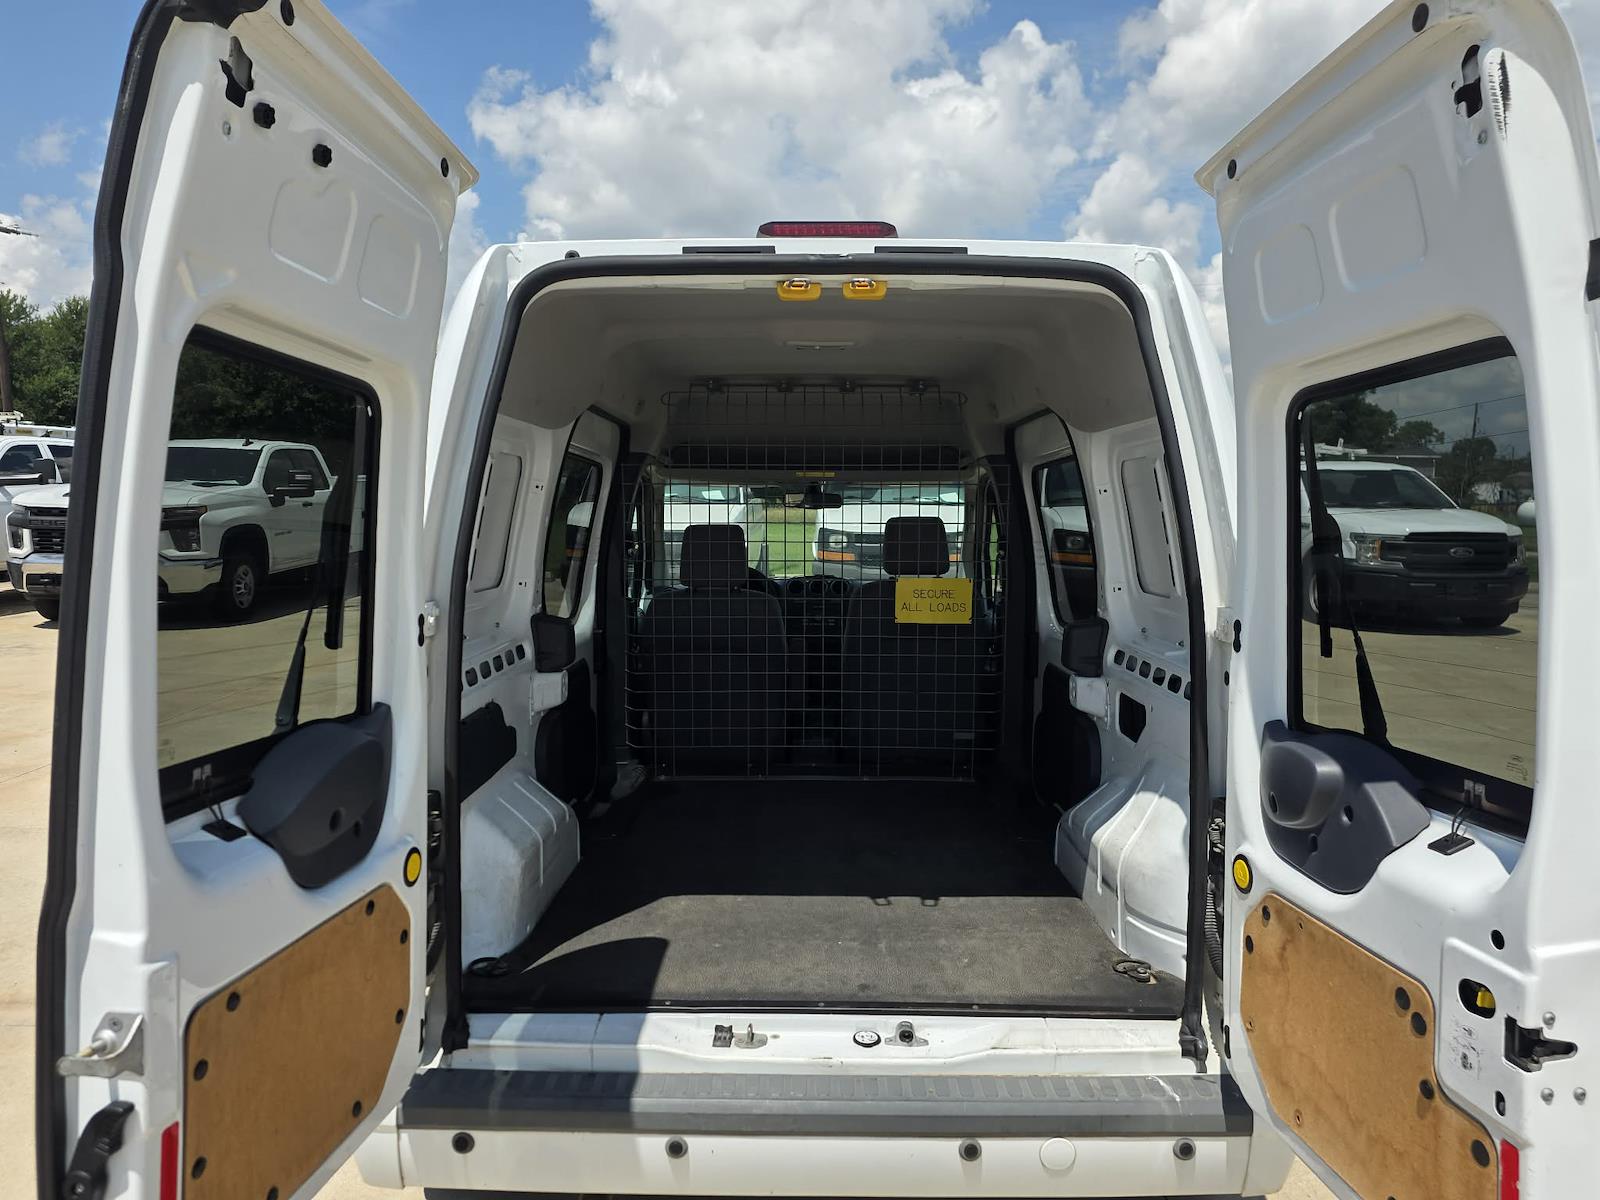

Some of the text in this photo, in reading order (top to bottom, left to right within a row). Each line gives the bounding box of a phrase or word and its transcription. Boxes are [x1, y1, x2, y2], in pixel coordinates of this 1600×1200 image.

[912, 589, 956, 599] SECURE
[901, 602, 967, 612] ALL LOADS
